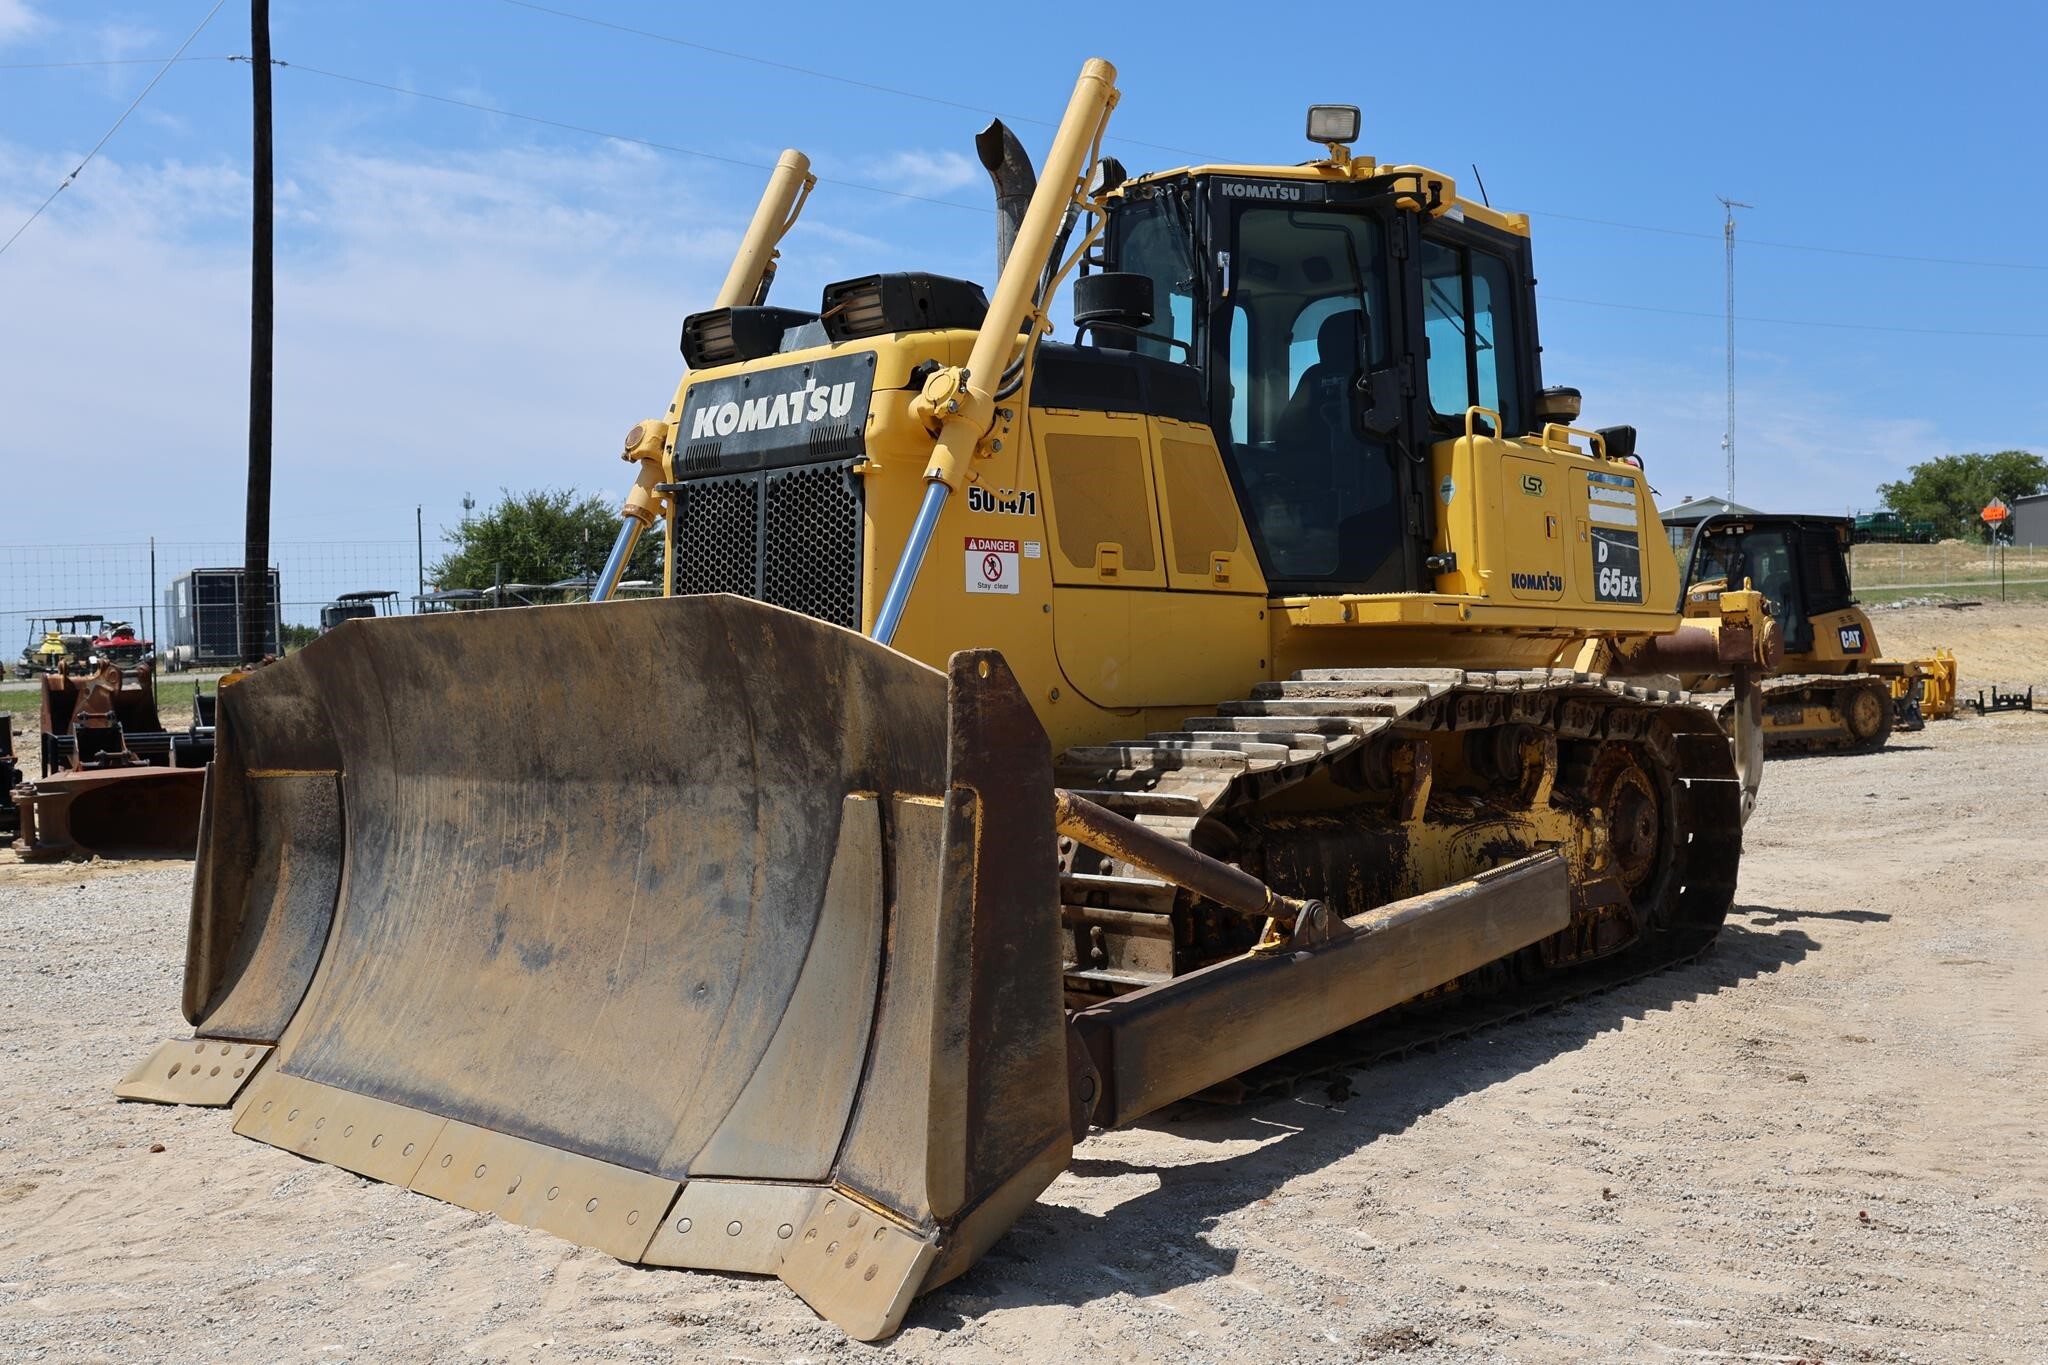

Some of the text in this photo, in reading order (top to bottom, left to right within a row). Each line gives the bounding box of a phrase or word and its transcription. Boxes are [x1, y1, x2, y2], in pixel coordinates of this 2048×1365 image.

[1221, 182, 1300, 200] KOMATSU
[691, 378, 855, 440] KOMATSU
[978, 540, 1016, 552] DANGER
[1598, 541, 1609, 563] D
[977, 582, 1009, 591] Stay clear
[1511, 571, 1562, 592] KOMATSU
[1600, 567, 1637, 598] 65EX
[1841, 630, 1861, 648] CAT
